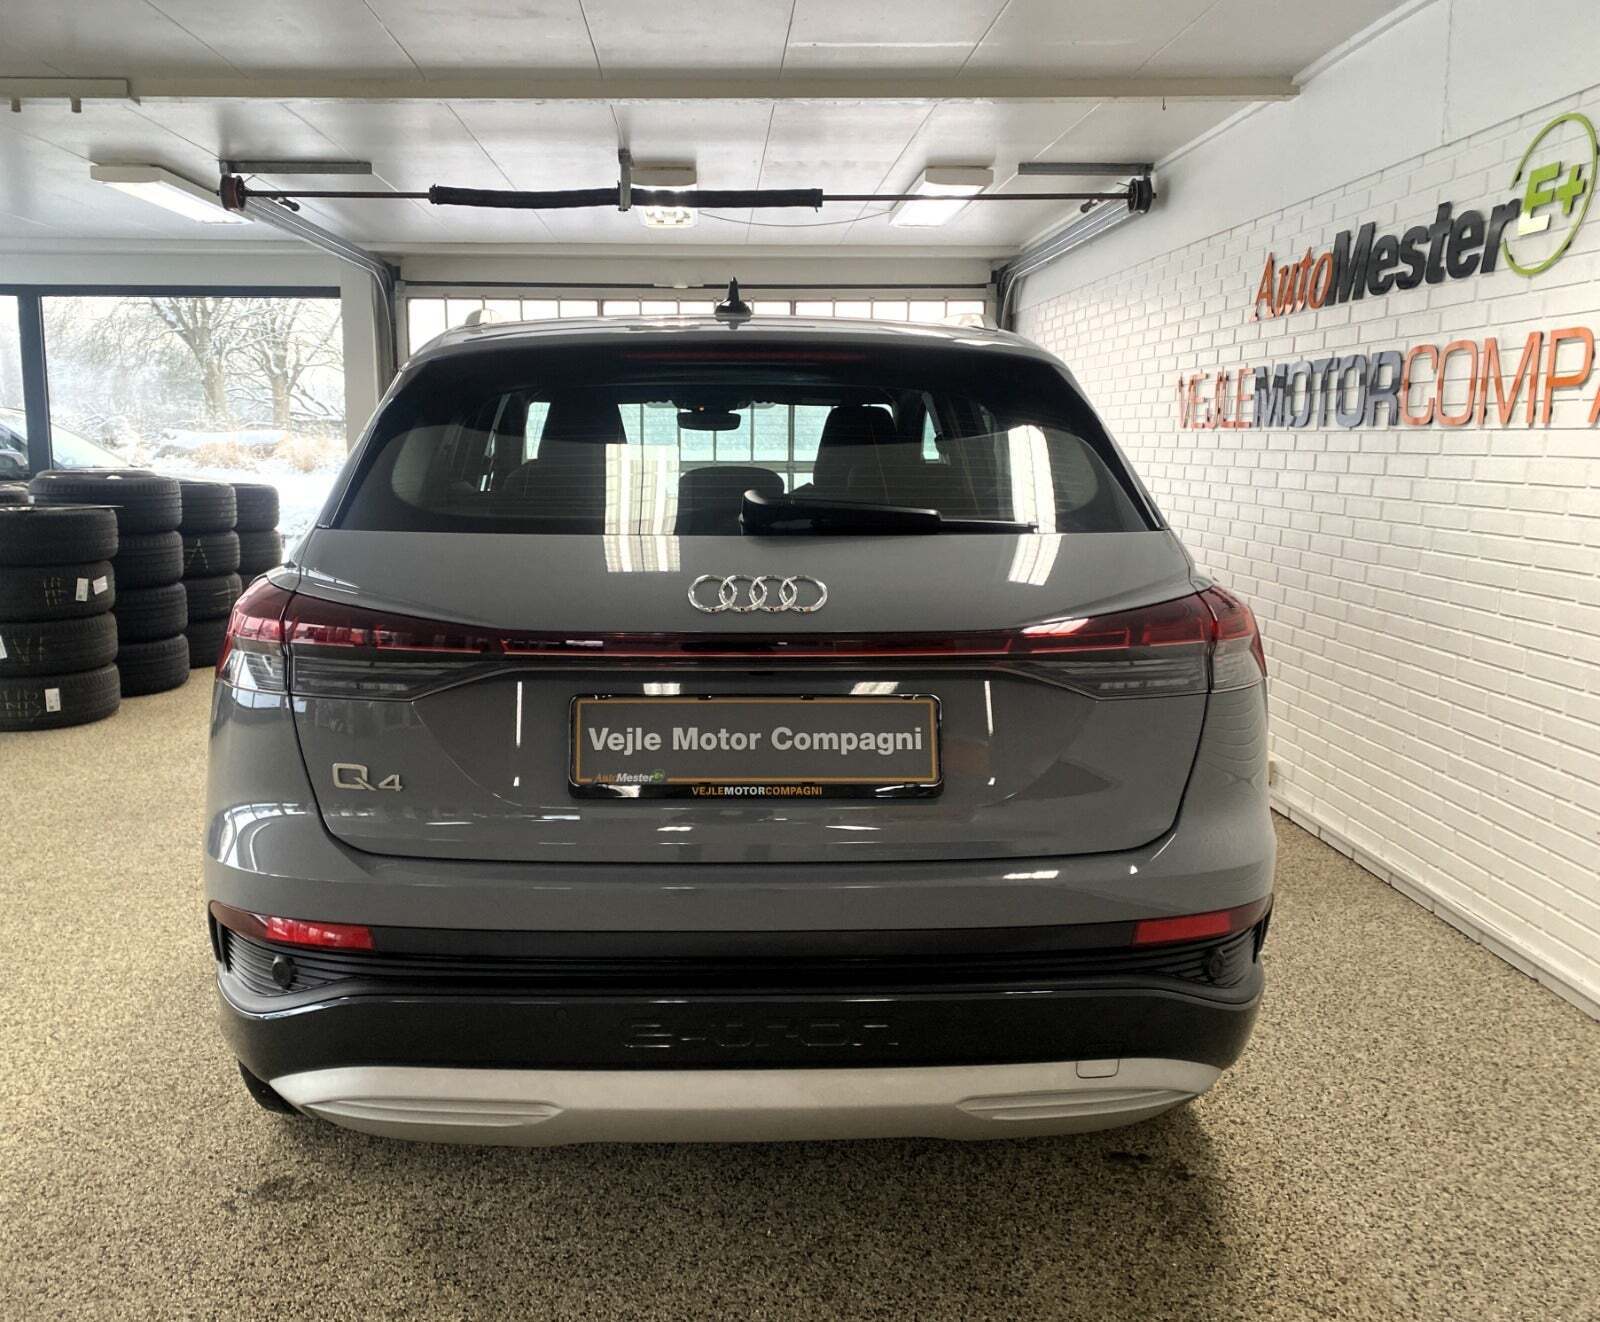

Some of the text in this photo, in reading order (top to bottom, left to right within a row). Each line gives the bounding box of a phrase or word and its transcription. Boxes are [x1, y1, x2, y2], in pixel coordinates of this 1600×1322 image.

[1250, 199, 1522, 322] AutoMester
[1178, 326, 1600, 429] VEJLEMOTORCOMP
[588, 727, 922, 756] Vejle Motor Compagni
[332, 762, 403, 792] Q4
[692, 786, 823, 796] VEJLEMOTORCOMPAGNI
